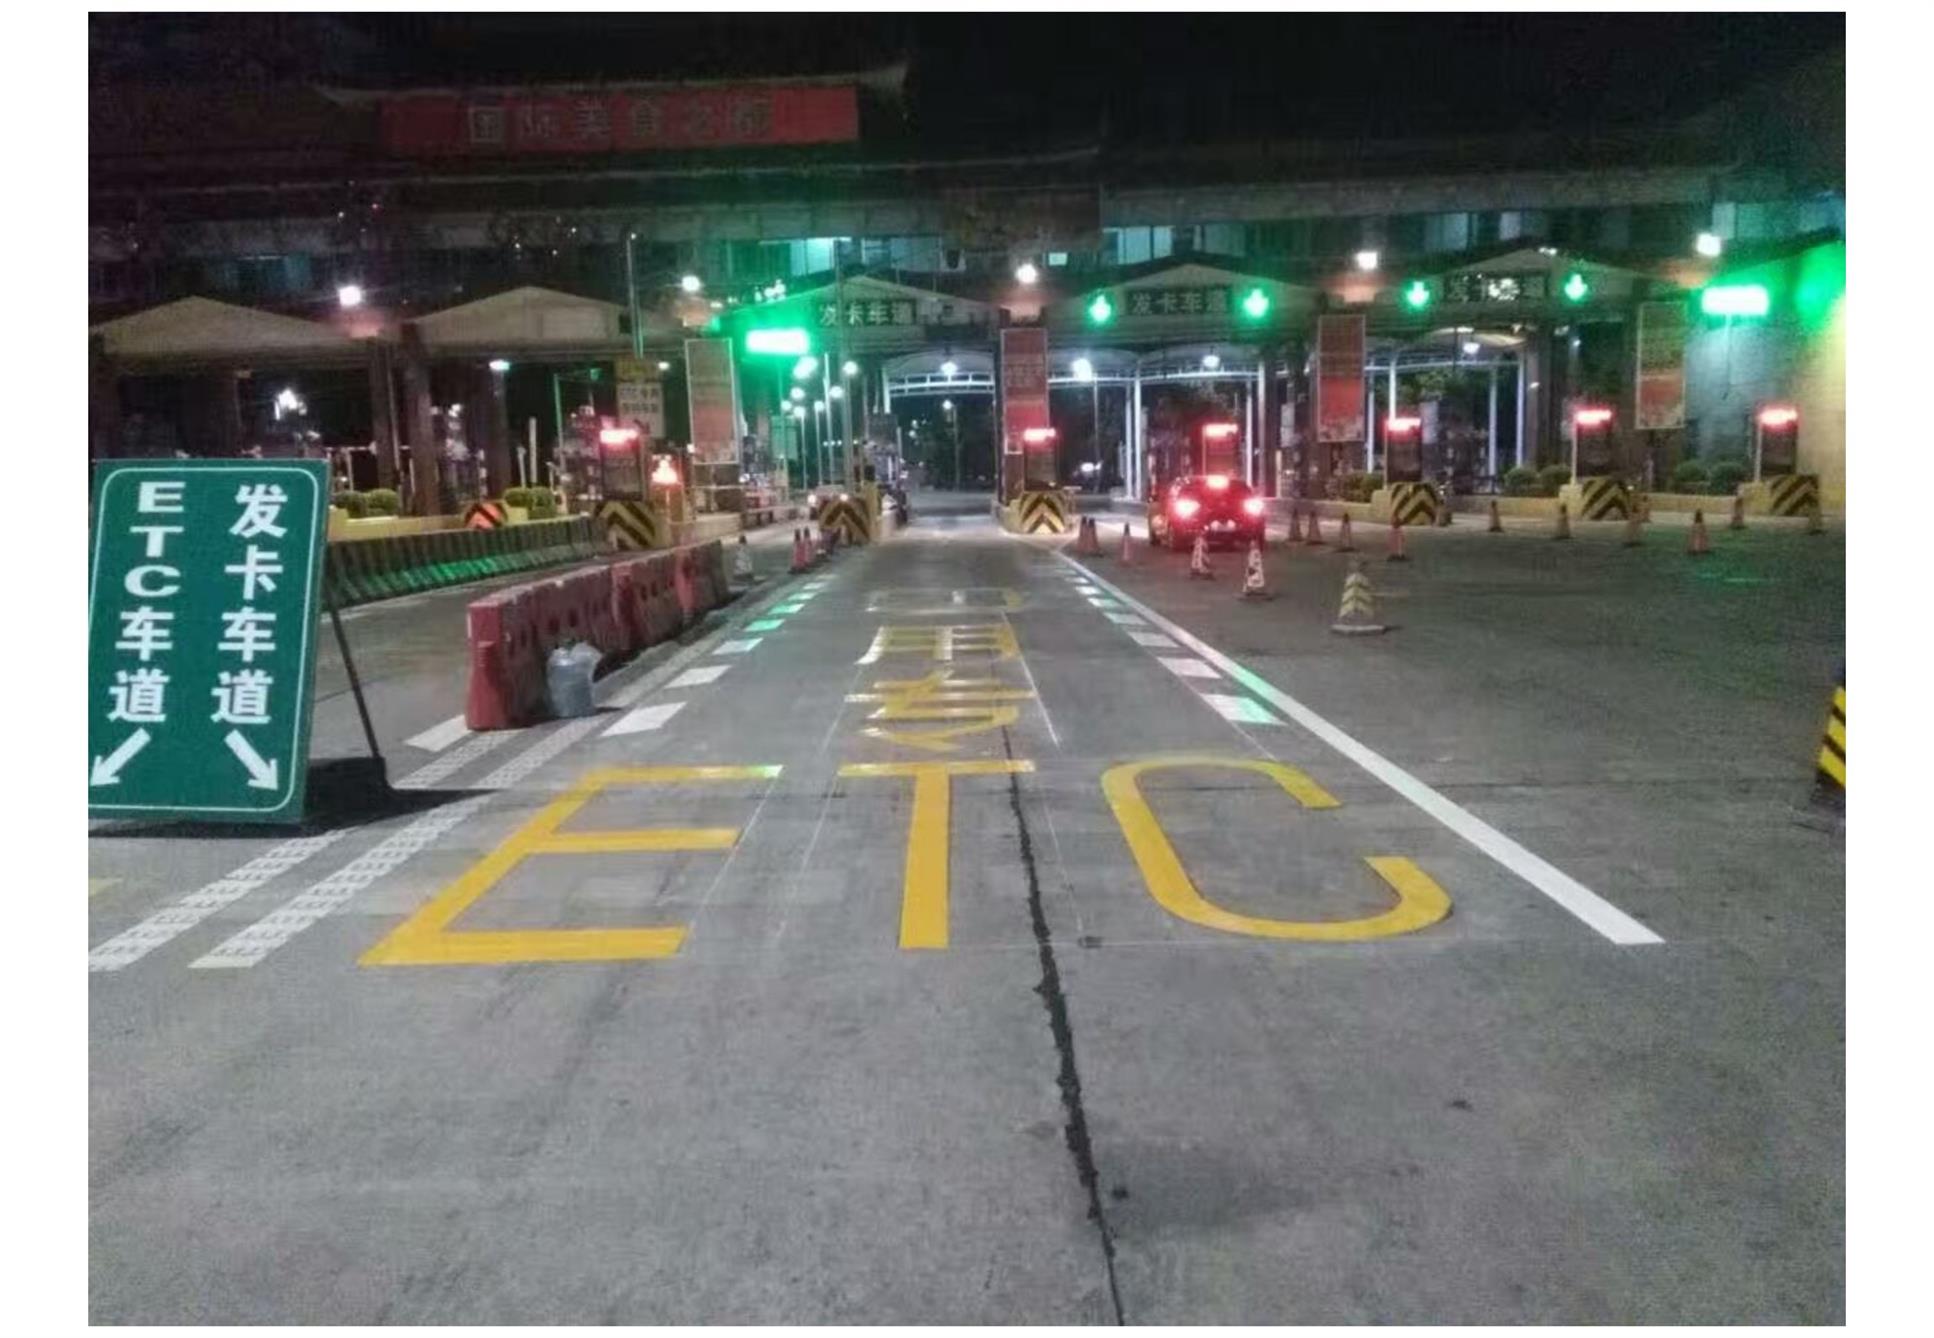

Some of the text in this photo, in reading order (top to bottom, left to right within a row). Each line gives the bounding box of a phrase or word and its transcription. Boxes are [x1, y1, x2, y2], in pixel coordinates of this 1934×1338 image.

[106, 481, 185, 723] ETC车道
[210, 484, 289, 725] 发卡车道
[358, 757, 1451, 967] ETC
